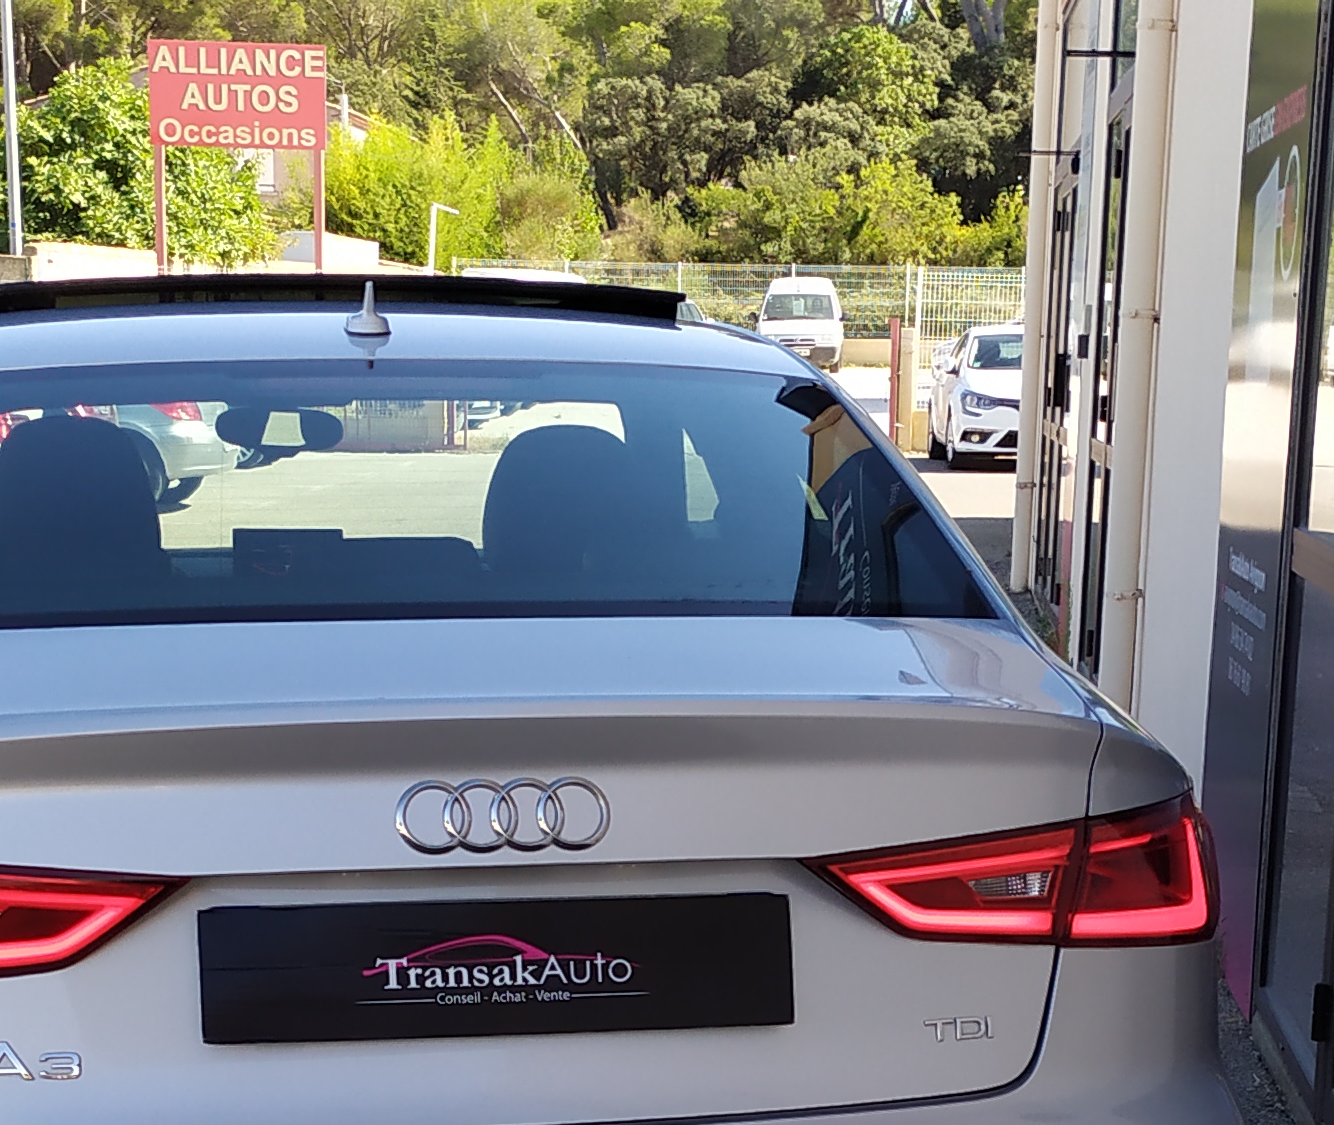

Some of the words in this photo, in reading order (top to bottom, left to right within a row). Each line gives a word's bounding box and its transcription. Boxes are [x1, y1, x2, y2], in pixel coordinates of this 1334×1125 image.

[151, 45, 325, 78] ALLIANCE
[180, 82, 299, 114] AUTOS
[158, 117, 317, 147] Occasions
[375, 952, 633, 989] TransakAuto
[436, 991, 481, 1005] Conseil
[491, 990, 527, 1003] Achat
[535, 990, 571, 1002] Vente
[923, 1016, 994, 1043] TDI
